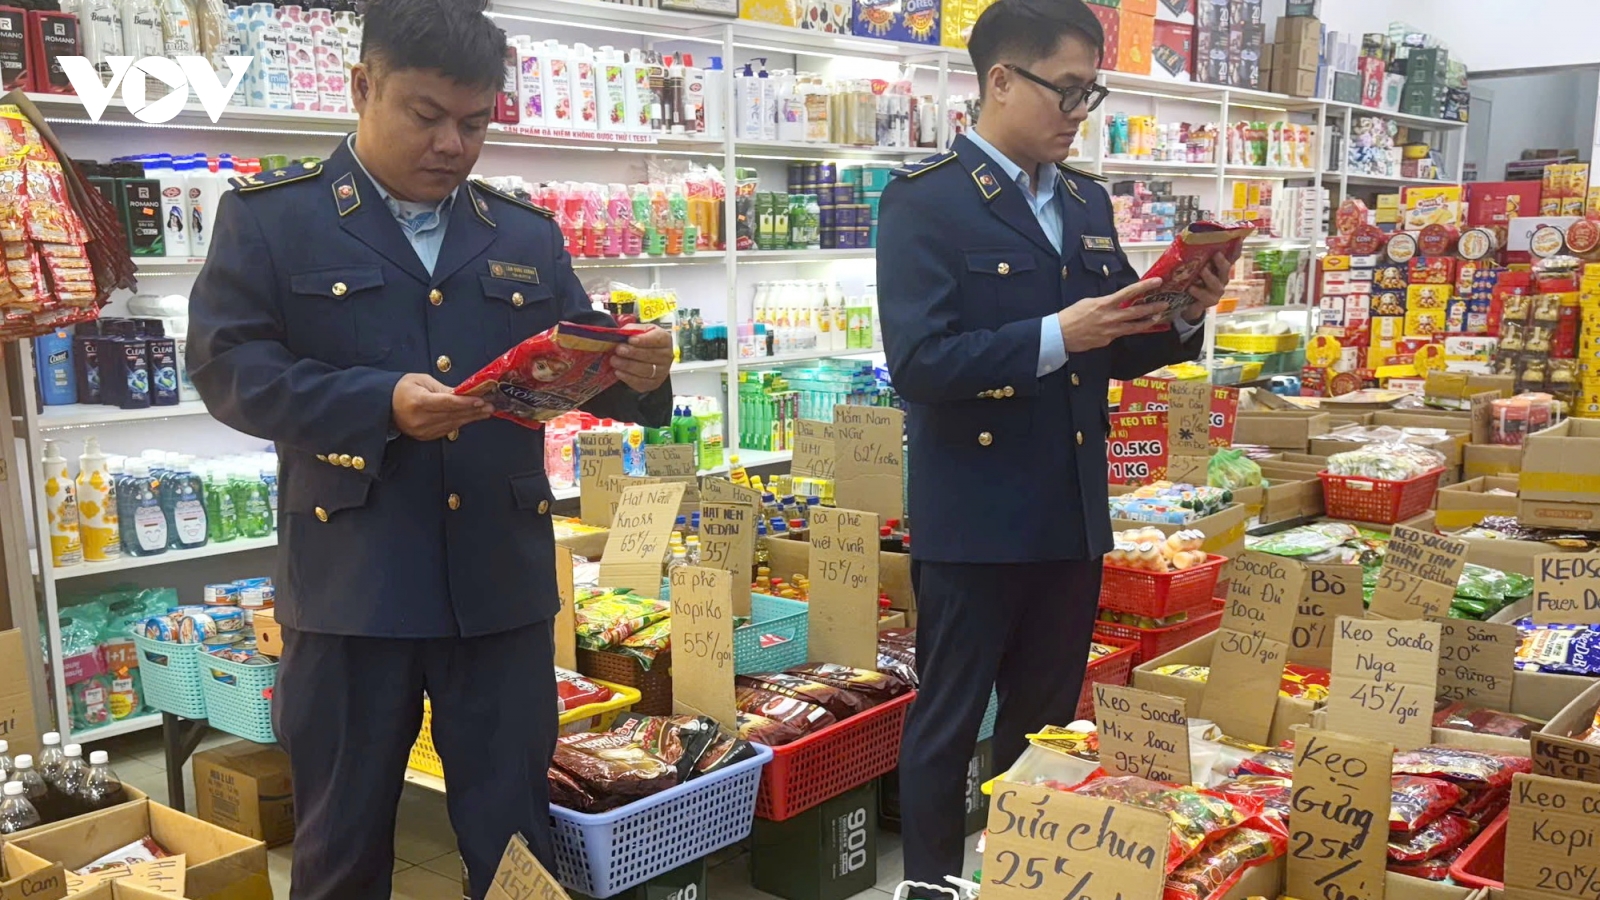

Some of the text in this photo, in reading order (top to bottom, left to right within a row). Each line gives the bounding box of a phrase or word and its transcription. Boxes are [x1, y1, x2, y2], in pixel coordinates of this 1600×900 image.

[44, 35, 75, 44] ROMANO
[130, 201, 160, 209] ROMANO
[151, 346, 173, 354] CLEAR
[1113, 441, 1161, 456] 0.5KG
[1125, 463, 1148, 477] KG
[703, 523, 740, 537] VEDAN
[1234, 553, 1286, 580] Socola
[691, 570, 717, 592] phê
[1311, 569, 1346, 596] Bò
[1386, 626, 1434, 653] Socola
[1467, 625, 1498, 643] Sâm
[1356, 653, 1396, 682] Nga
[1140, 702, 1186, 726] Socola
[1103, 719, 1134, 742] Mix
[1298, 736, 1368, 782] Kẹo
[1519, 781, 1566, 812] Kẹo
[847, 807, 866, 871] 900
[1532, 818, 1593, 857] Kopi
[20, 875, 59, 898] Cam
